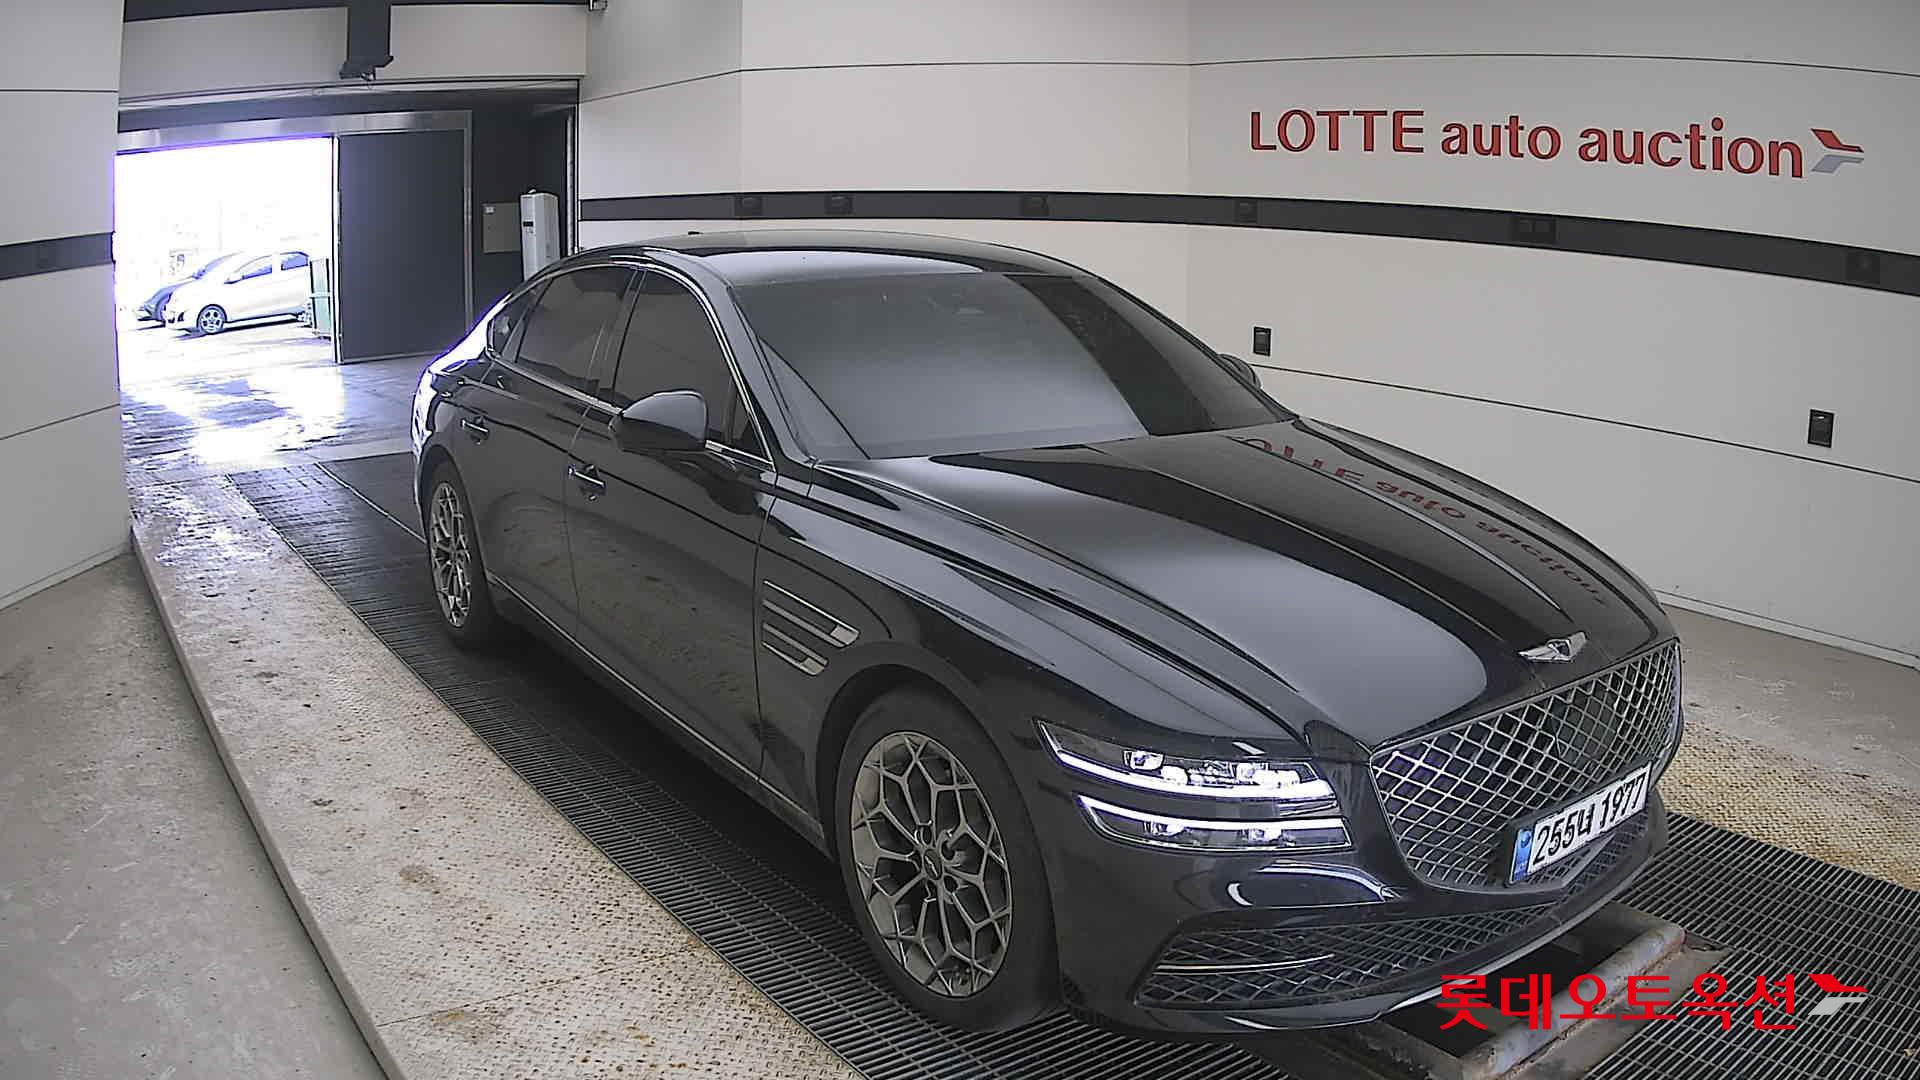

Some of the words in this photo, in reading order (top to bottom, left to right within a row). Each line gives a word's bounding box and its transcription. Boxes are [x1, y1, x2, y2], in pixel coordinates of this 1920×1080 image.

[1250, 110, 1425, 153] LOTTE
[1441, 115, 1562, 160] auto
[1577, 117, 1804, 179] auction
[1599, 774, 1648, 829] 1977
